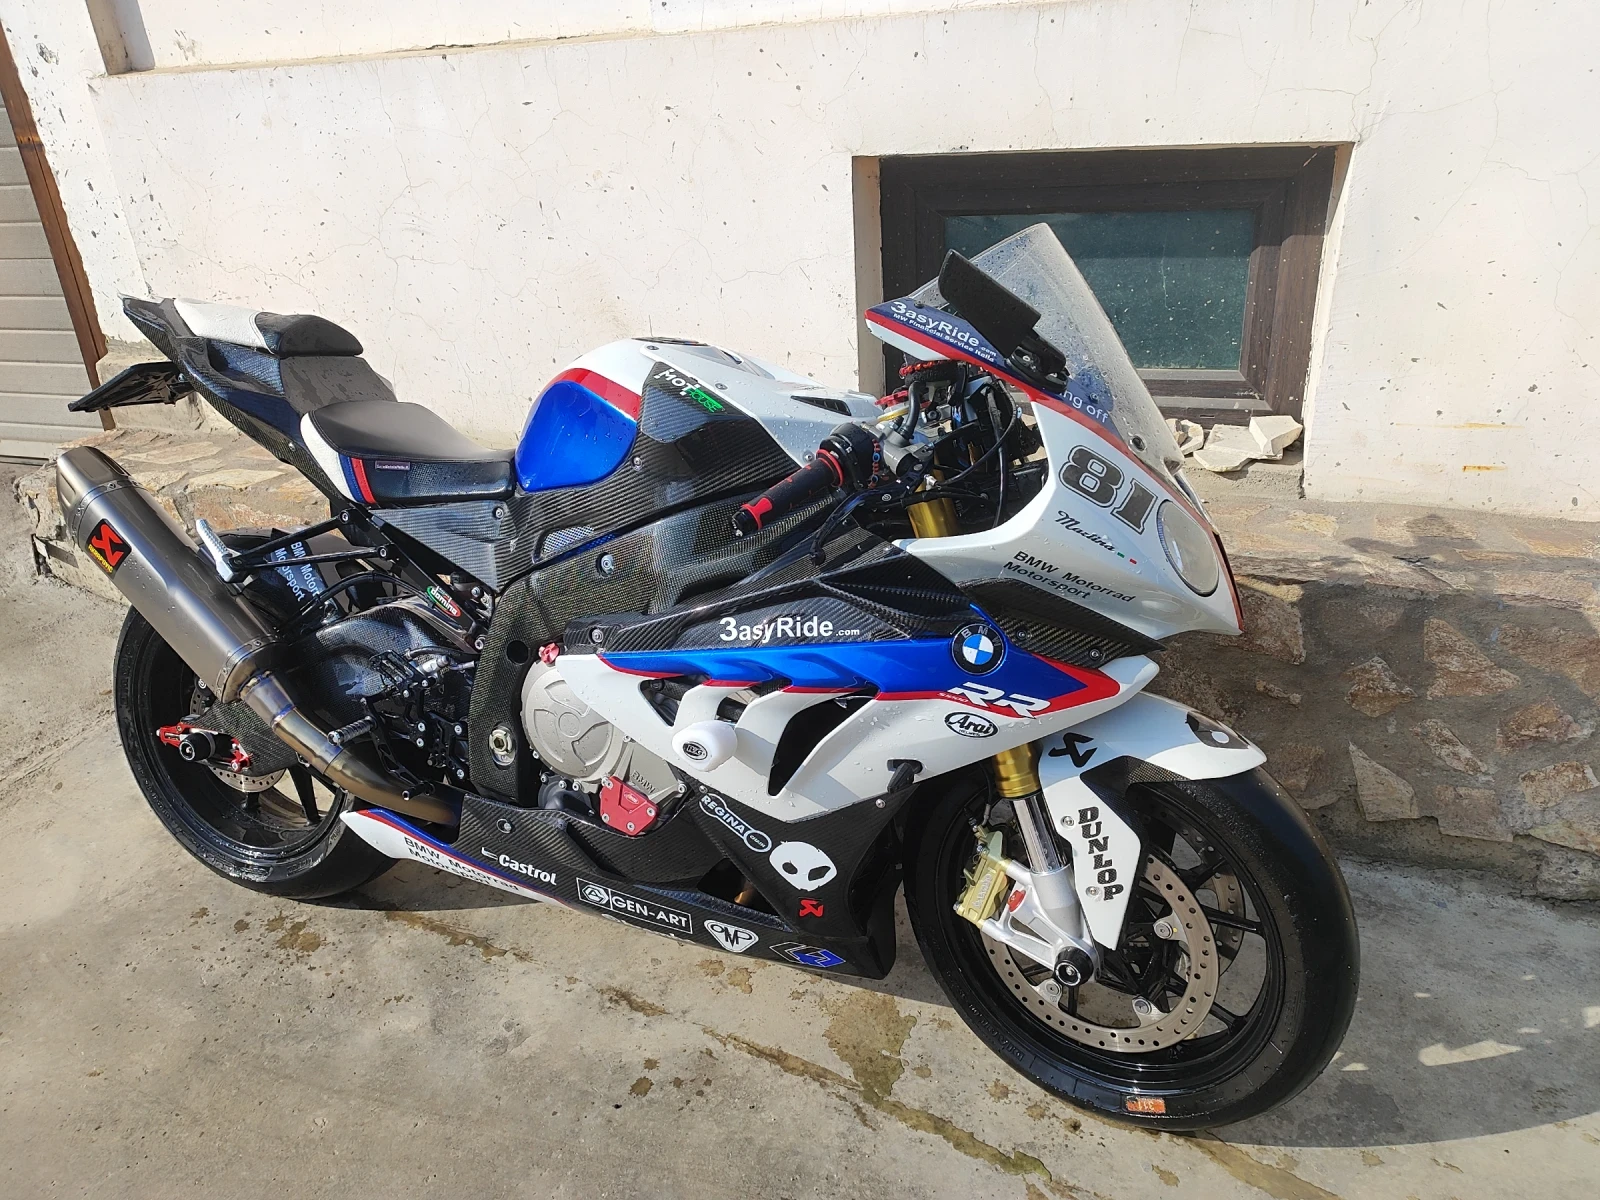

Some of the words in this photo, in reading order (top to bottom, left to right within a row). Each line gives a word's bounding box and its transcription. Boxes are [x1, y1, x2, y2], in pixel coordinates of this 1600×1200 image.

[1086, 404, 1108, 424] off
[1058, 444, 1159, 535] 81
[1003, 561, 1091, 601] Motorsport
[1013, 550, 1059, 574] BMW
[1061, 571, 1136, 603] Motorrad
[960, 626, 1002, 648] BMW
[947, 681, 1052, 719] RR
[950, 714, 993, 734] Arai
[701, 794, 746, 835] REGINA
[404, 836, 440, 860] BMW
[1078, 806, 1124, 901] DUNLOP
[499, 854, 557, 886] Castrol
[612, 896, 688, 928] GEN-ART
[710, 923, 752, 948] OMP
